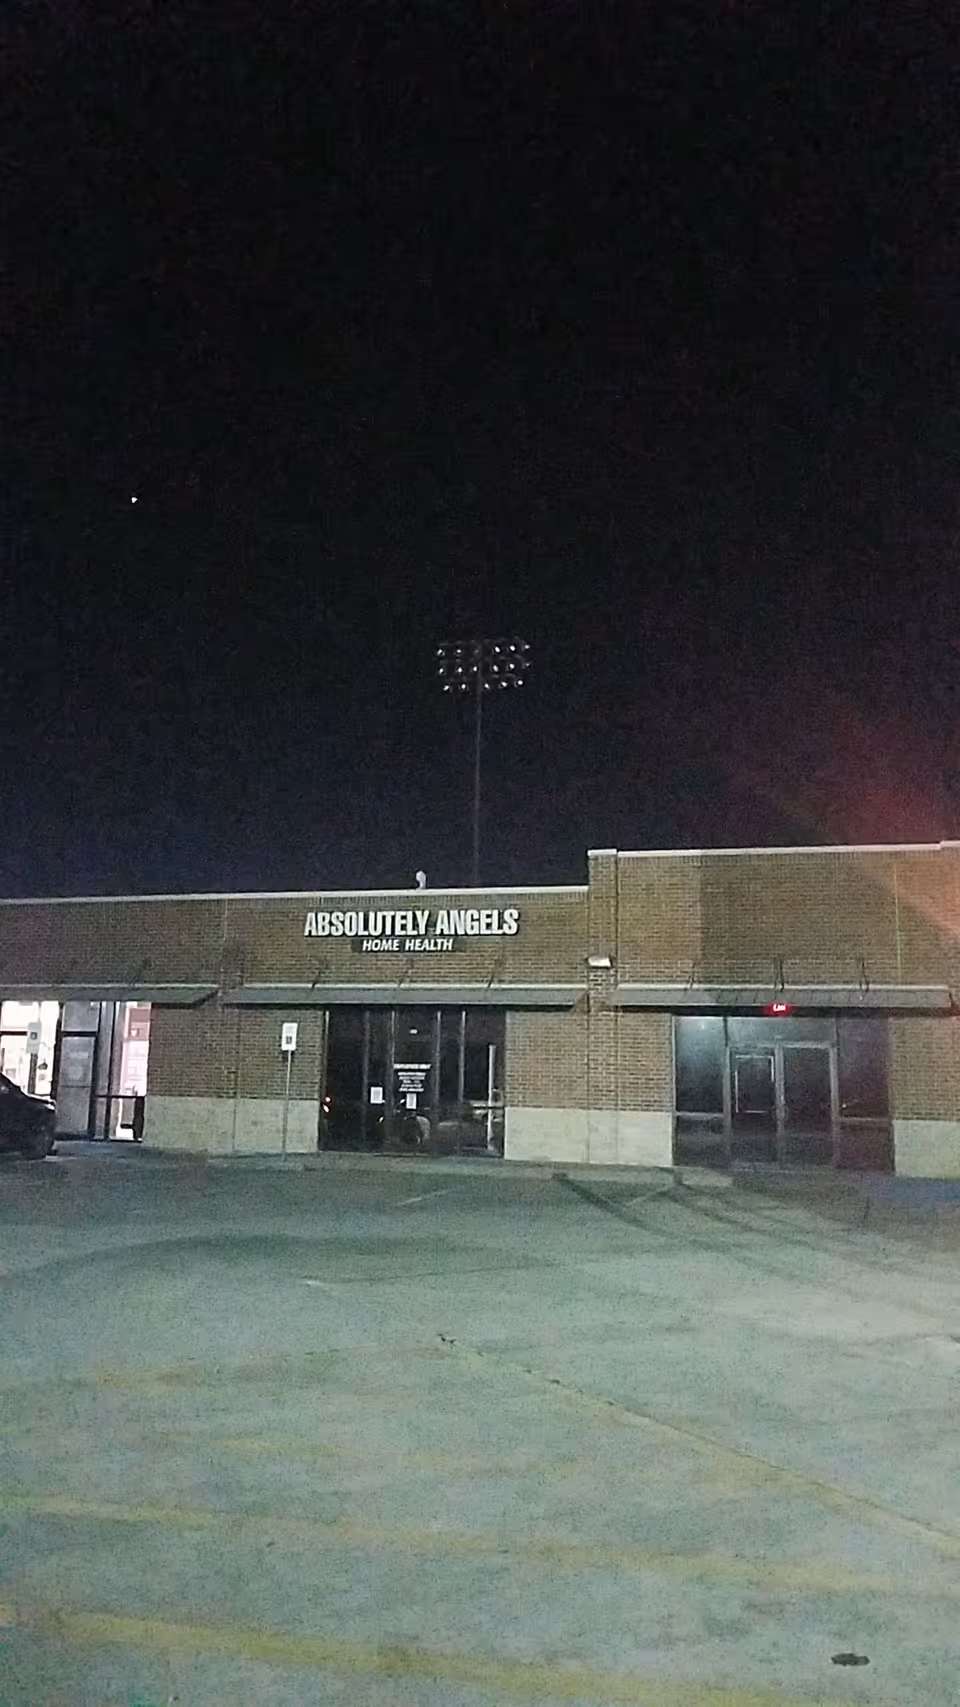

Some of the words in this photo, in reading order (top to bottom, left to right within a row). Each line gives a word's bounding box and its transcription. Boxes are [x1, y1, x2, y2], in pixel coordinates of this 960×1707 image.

[304, 910, 430, 937] ABSOLUTELY
[435, 909, 520, 936] ANGELS
[362, 939, 400, 951] HOME
[405, 938, 453, 951] HEALTH
